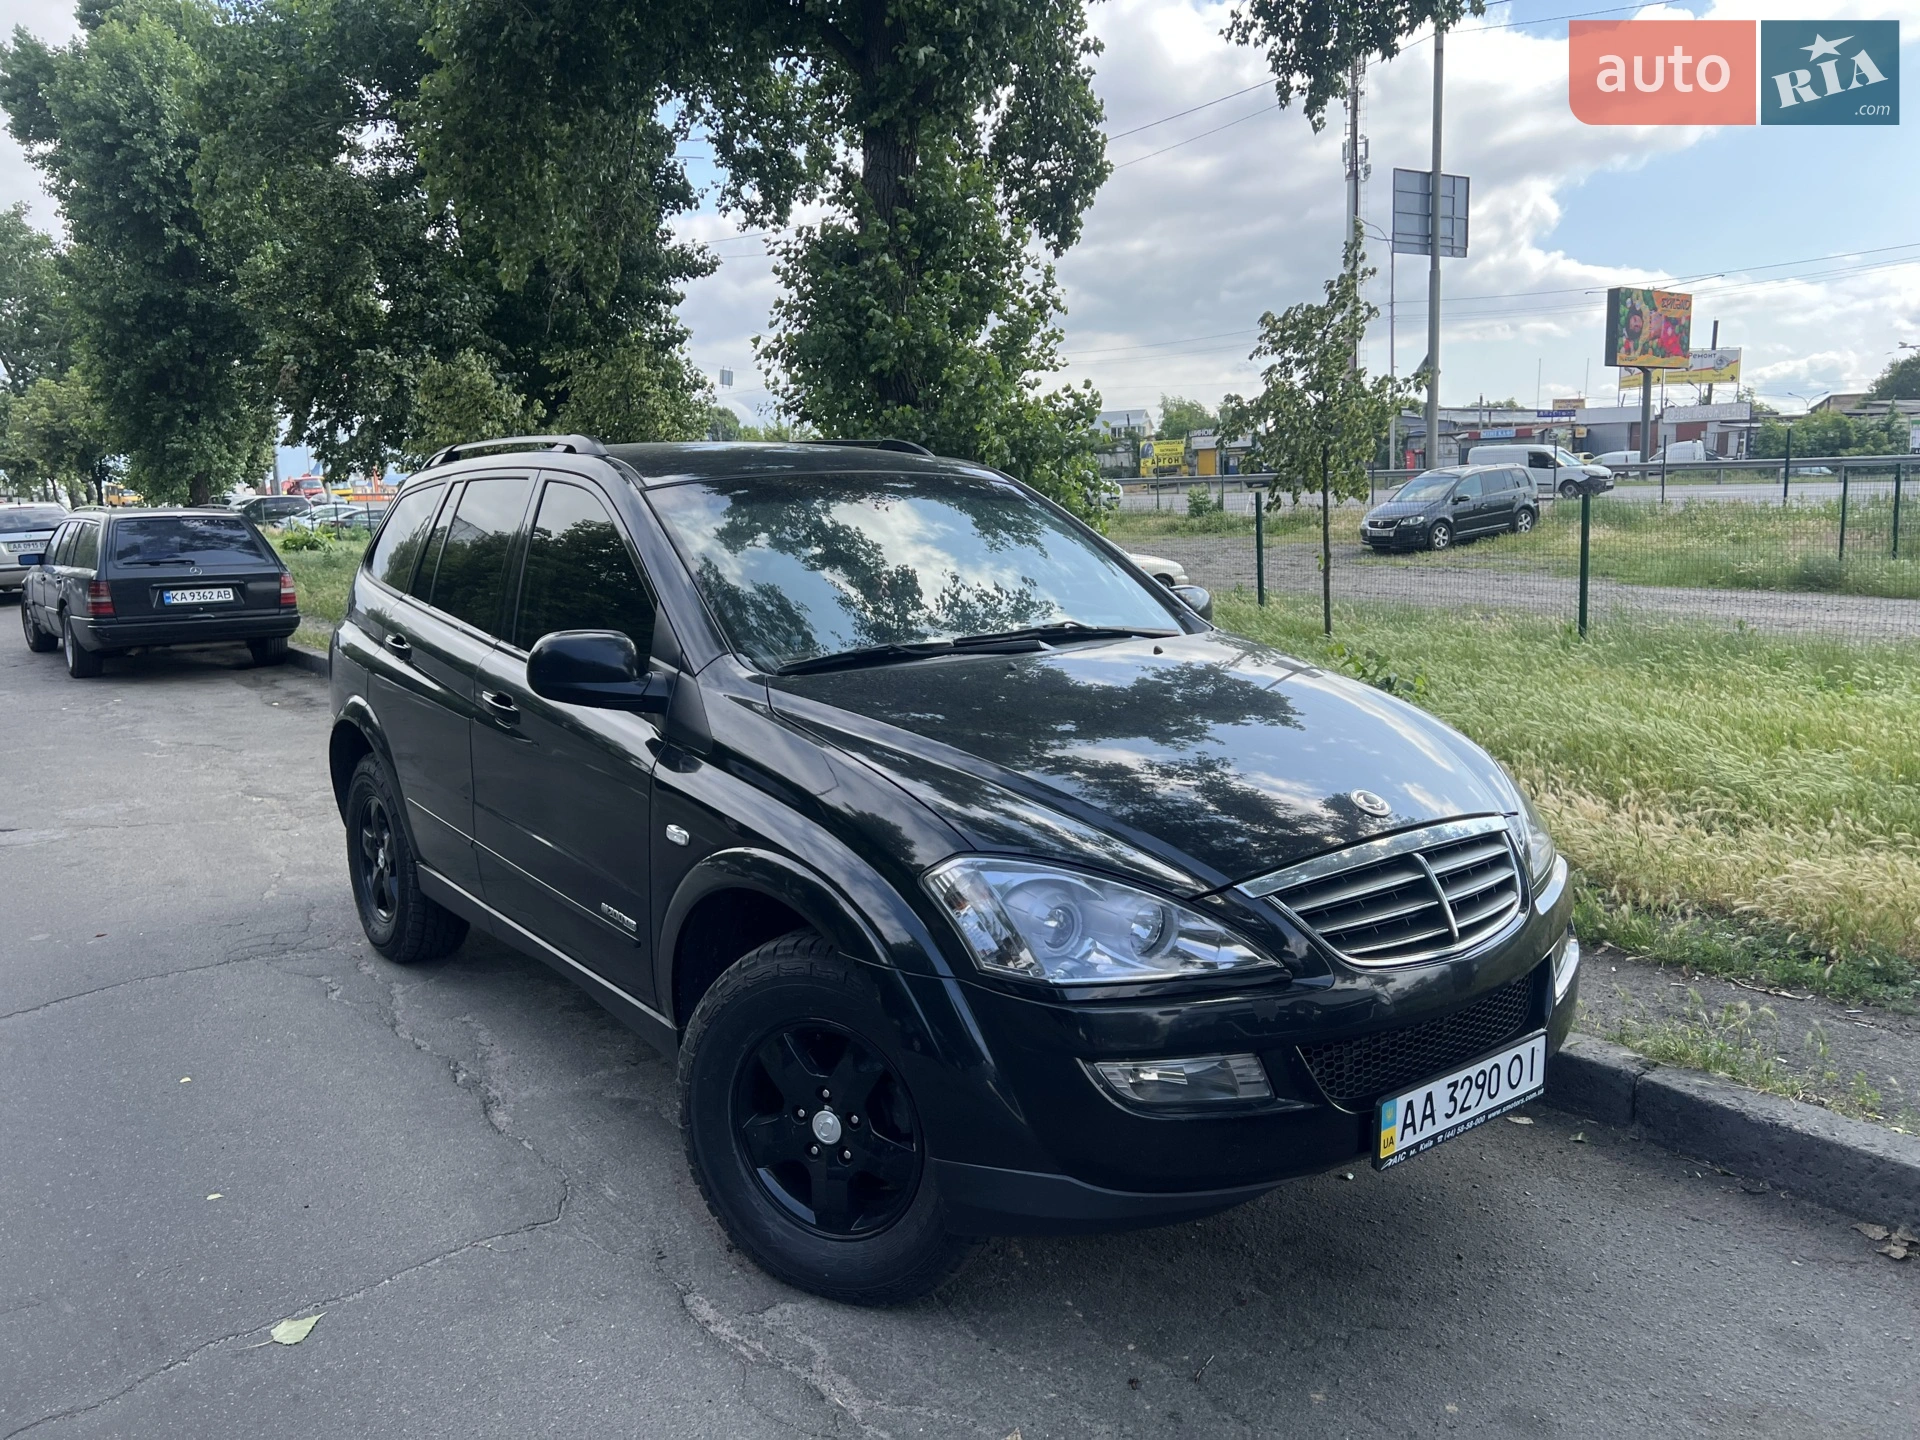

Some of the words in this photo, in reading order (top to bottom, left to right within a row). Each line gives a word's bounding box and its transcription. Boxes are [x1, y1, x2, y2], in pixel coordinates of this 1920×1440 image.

[1150, 456, 1180, 465] АРГОН
[171, 592, 187, 602] KA
[189, 591, 214, 601] 9362
[217, 590, 232, 600] AB
[1400, 1091, 1436, 1142] AA
[1444, 1062, 1501, 1120] 3290
[1383, 1137, 1395, 1149] UA
